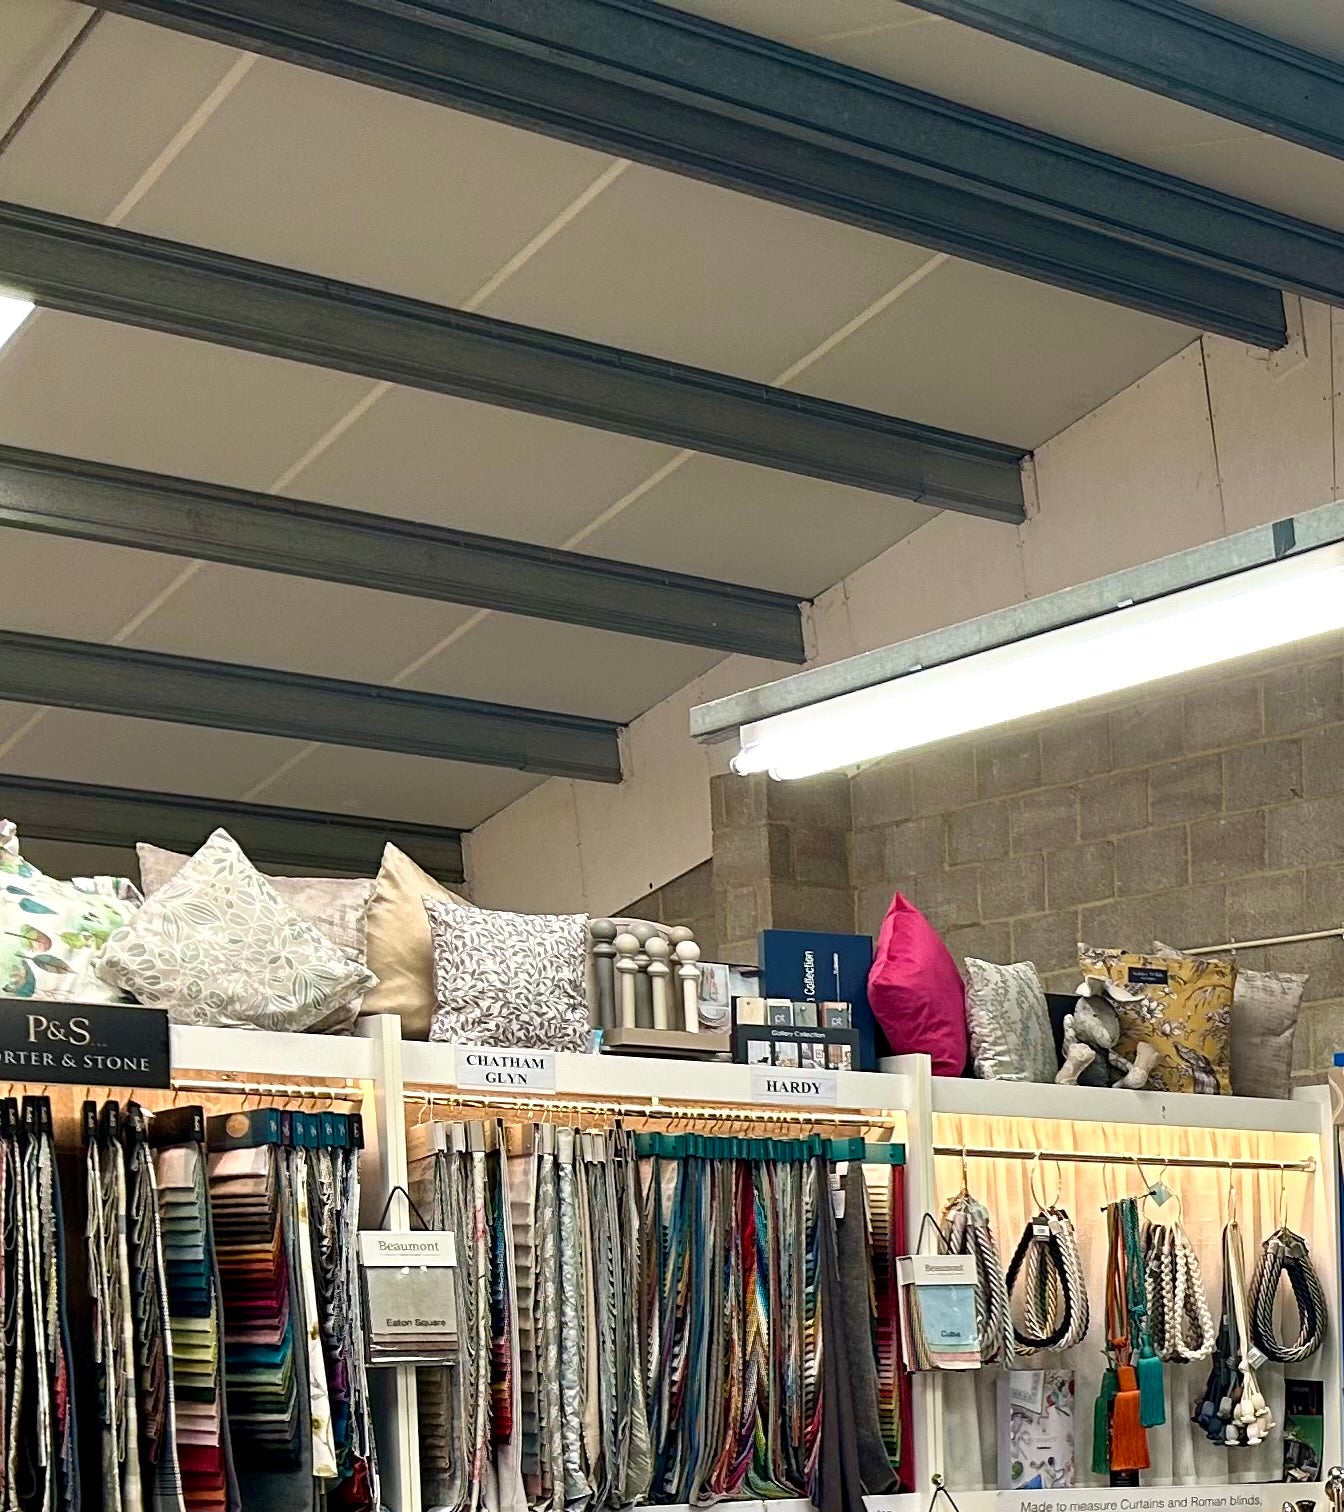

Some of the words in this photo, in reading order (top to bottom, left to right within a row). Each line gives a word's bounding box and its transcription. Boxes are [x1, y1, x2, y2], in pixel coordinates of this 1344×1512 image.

[26, 1014, 91, 1046] P&S
[61, 1053, 78, 1068] &
[83, 1054, 150, 1072] STONE
[466, 1054, 545, 1070] CHATHAM
[485, 1071, 528, 1085] GLYN
[766, 1079, 823, 1095] HARDY
[378, 1240, 440, 1252] Beaumont
[1056, 1501, 1067, 1512] to
[1070, 1501, 1118, 1512] measure
[1120, 1499, 1165, 1511] Curtains
[1167, 1497, 1188, 1509] and
[1191, 1495, 1227, 1508] Roman
